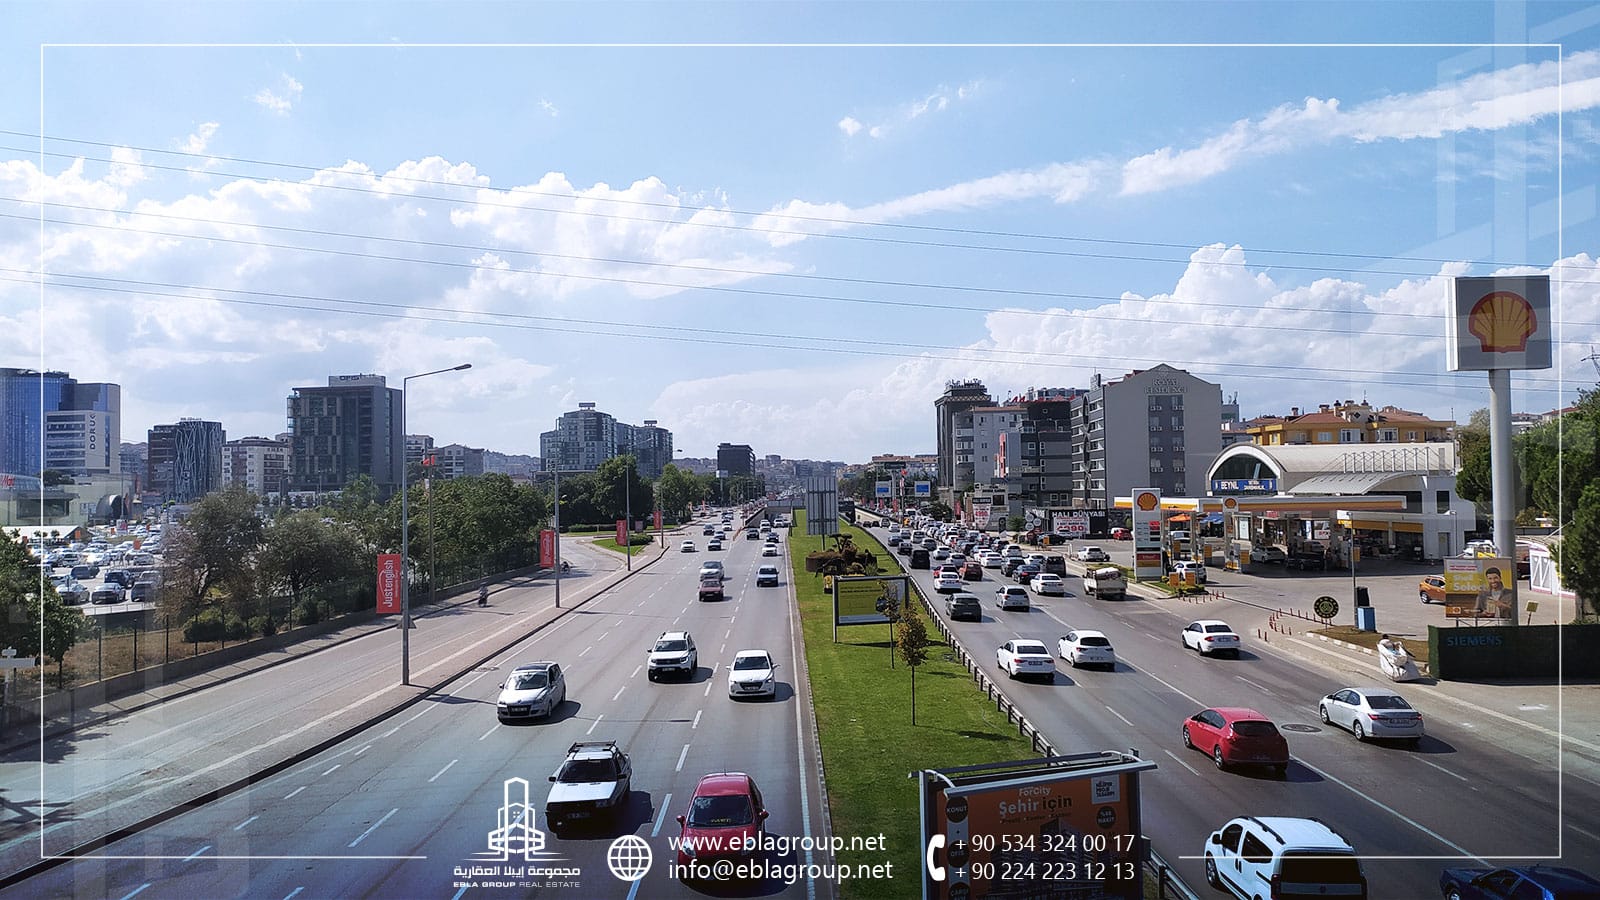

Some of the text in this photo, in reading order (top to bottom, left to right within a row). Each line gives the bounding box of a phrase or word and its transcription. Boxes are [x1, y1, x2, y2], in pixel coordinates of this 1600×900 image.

[1447, 634, 1502, 646] SIEMENS
[1000, 799, 1039, 818] Şehir
[1042, 795, 1072, 811] için
